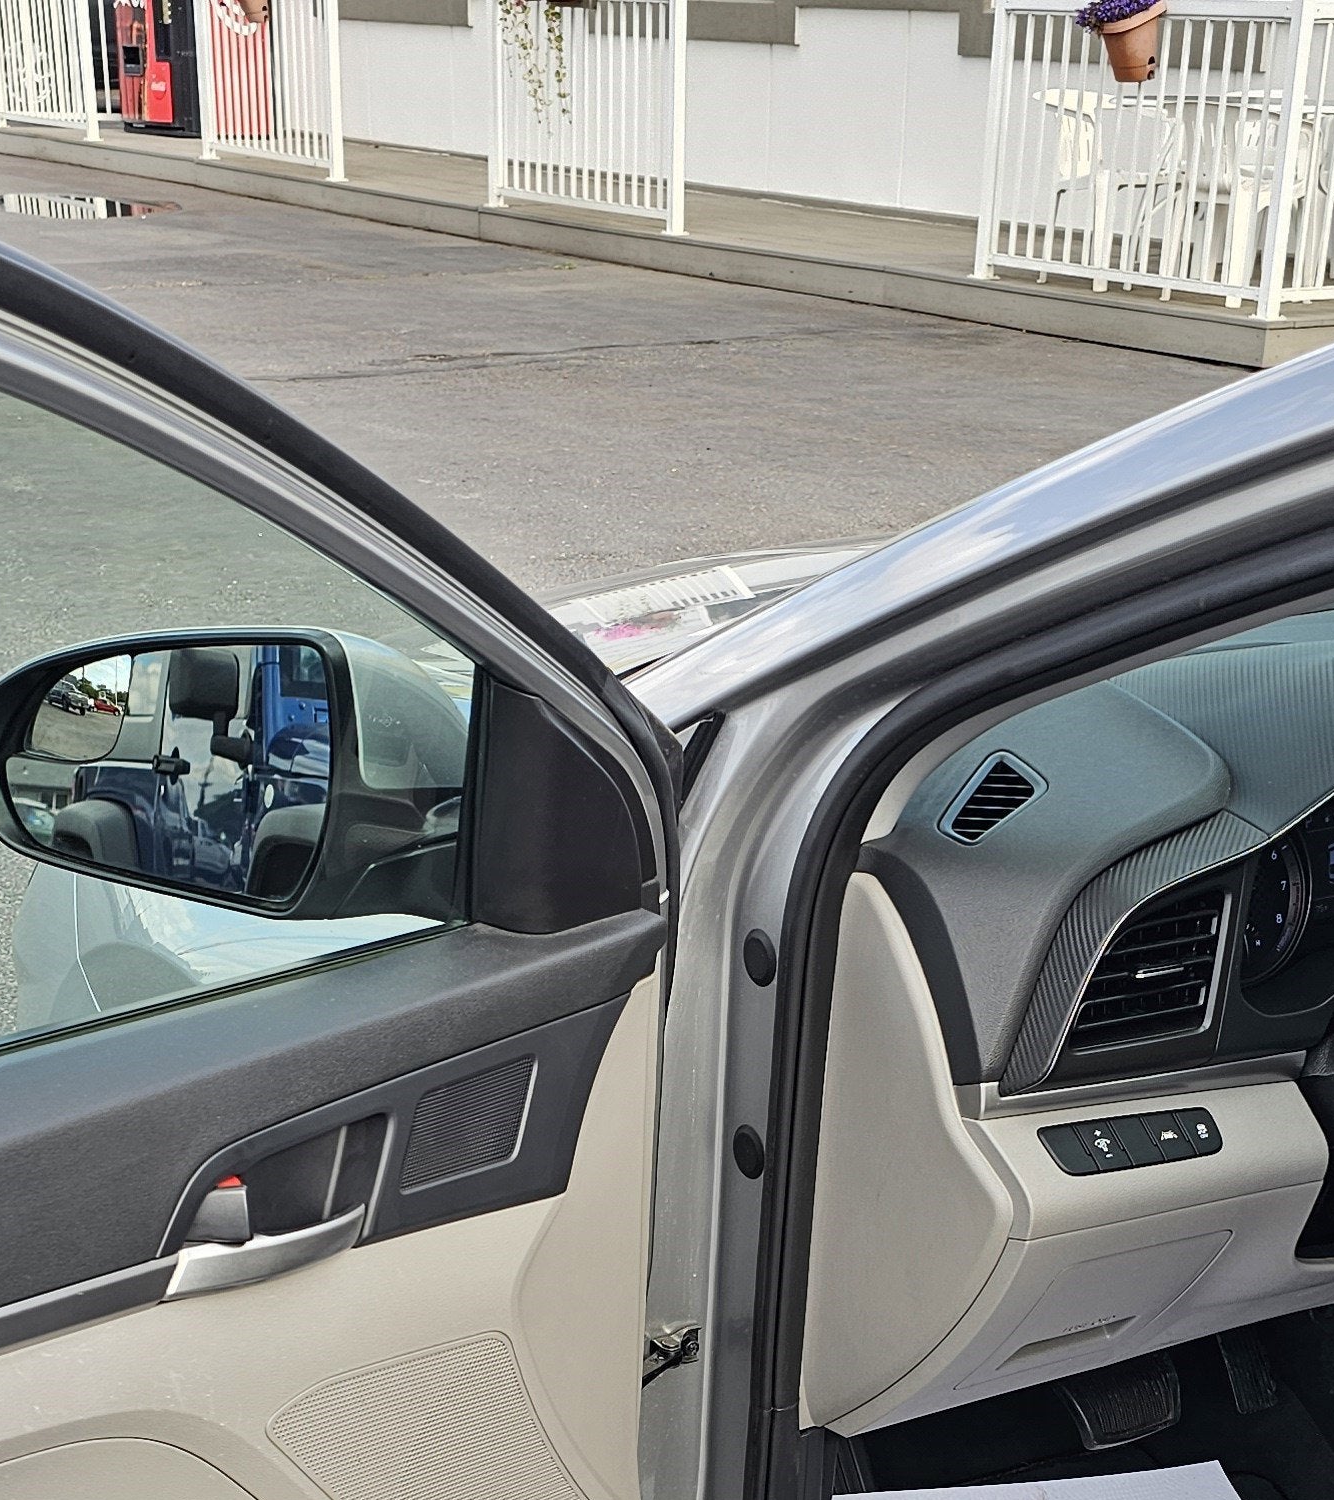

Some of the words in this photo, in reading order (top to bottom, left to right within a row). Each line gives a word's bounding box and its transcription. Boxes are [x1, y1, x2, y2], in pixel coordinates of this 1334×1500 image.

[1271, 851, 1278, 861] 6
[1280, 880, 1287, 891] 7
[1275, 913, 1283, 924] 8
